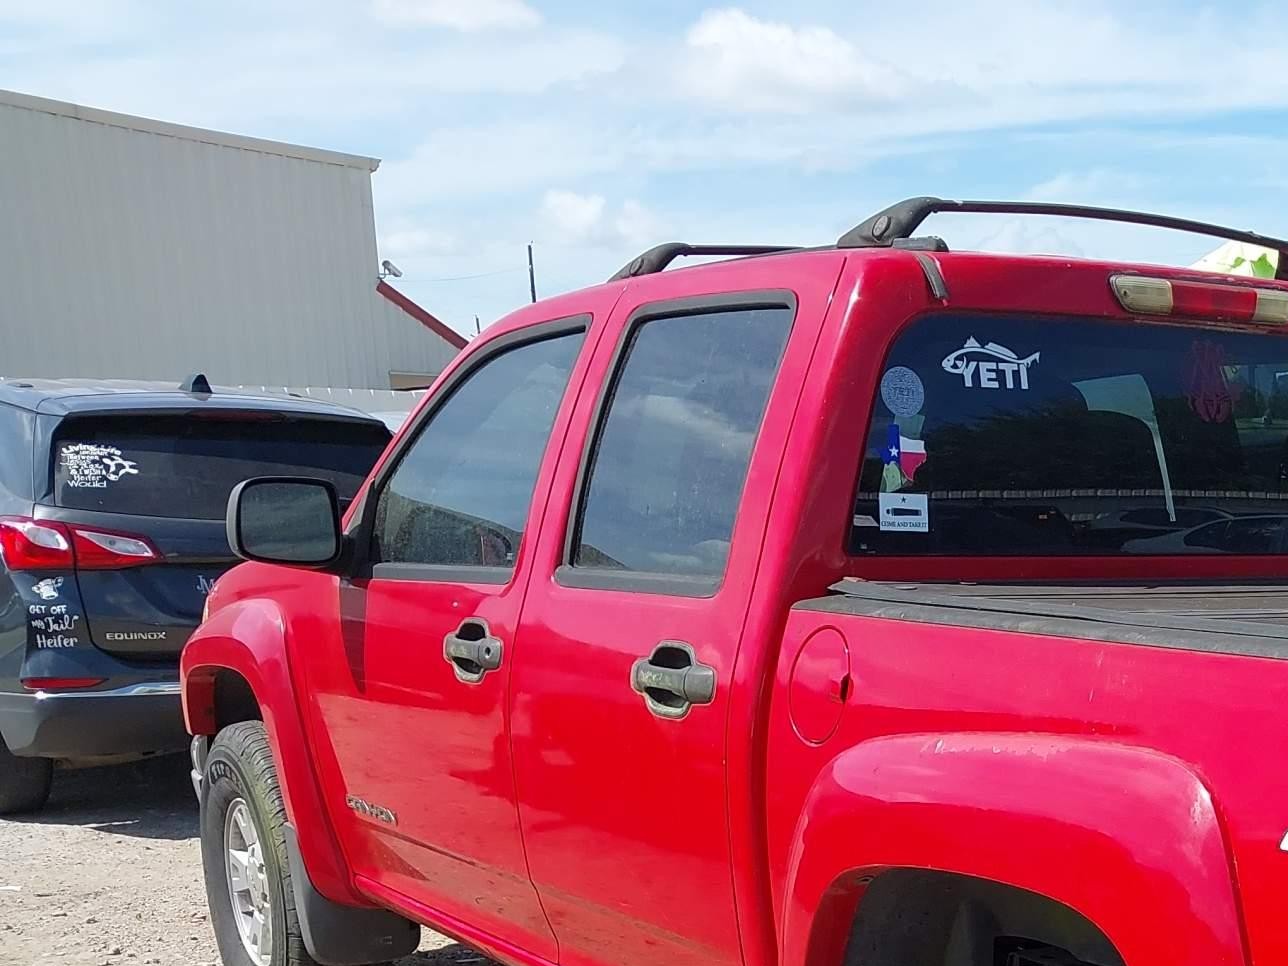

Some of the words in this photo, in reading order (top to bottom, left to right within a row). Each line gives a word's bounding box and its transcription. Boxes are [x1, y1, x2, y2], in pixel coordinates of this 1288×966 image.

[962, 361, 1030, 389] YETI
[67, 480, 107, 488] Would
[29, 605, 47, 614] GET
[50, 605, 67, 615] OFF
[36, 634, 78, 649] Heifer
[106, 632, 167, 641] EQUINOX
